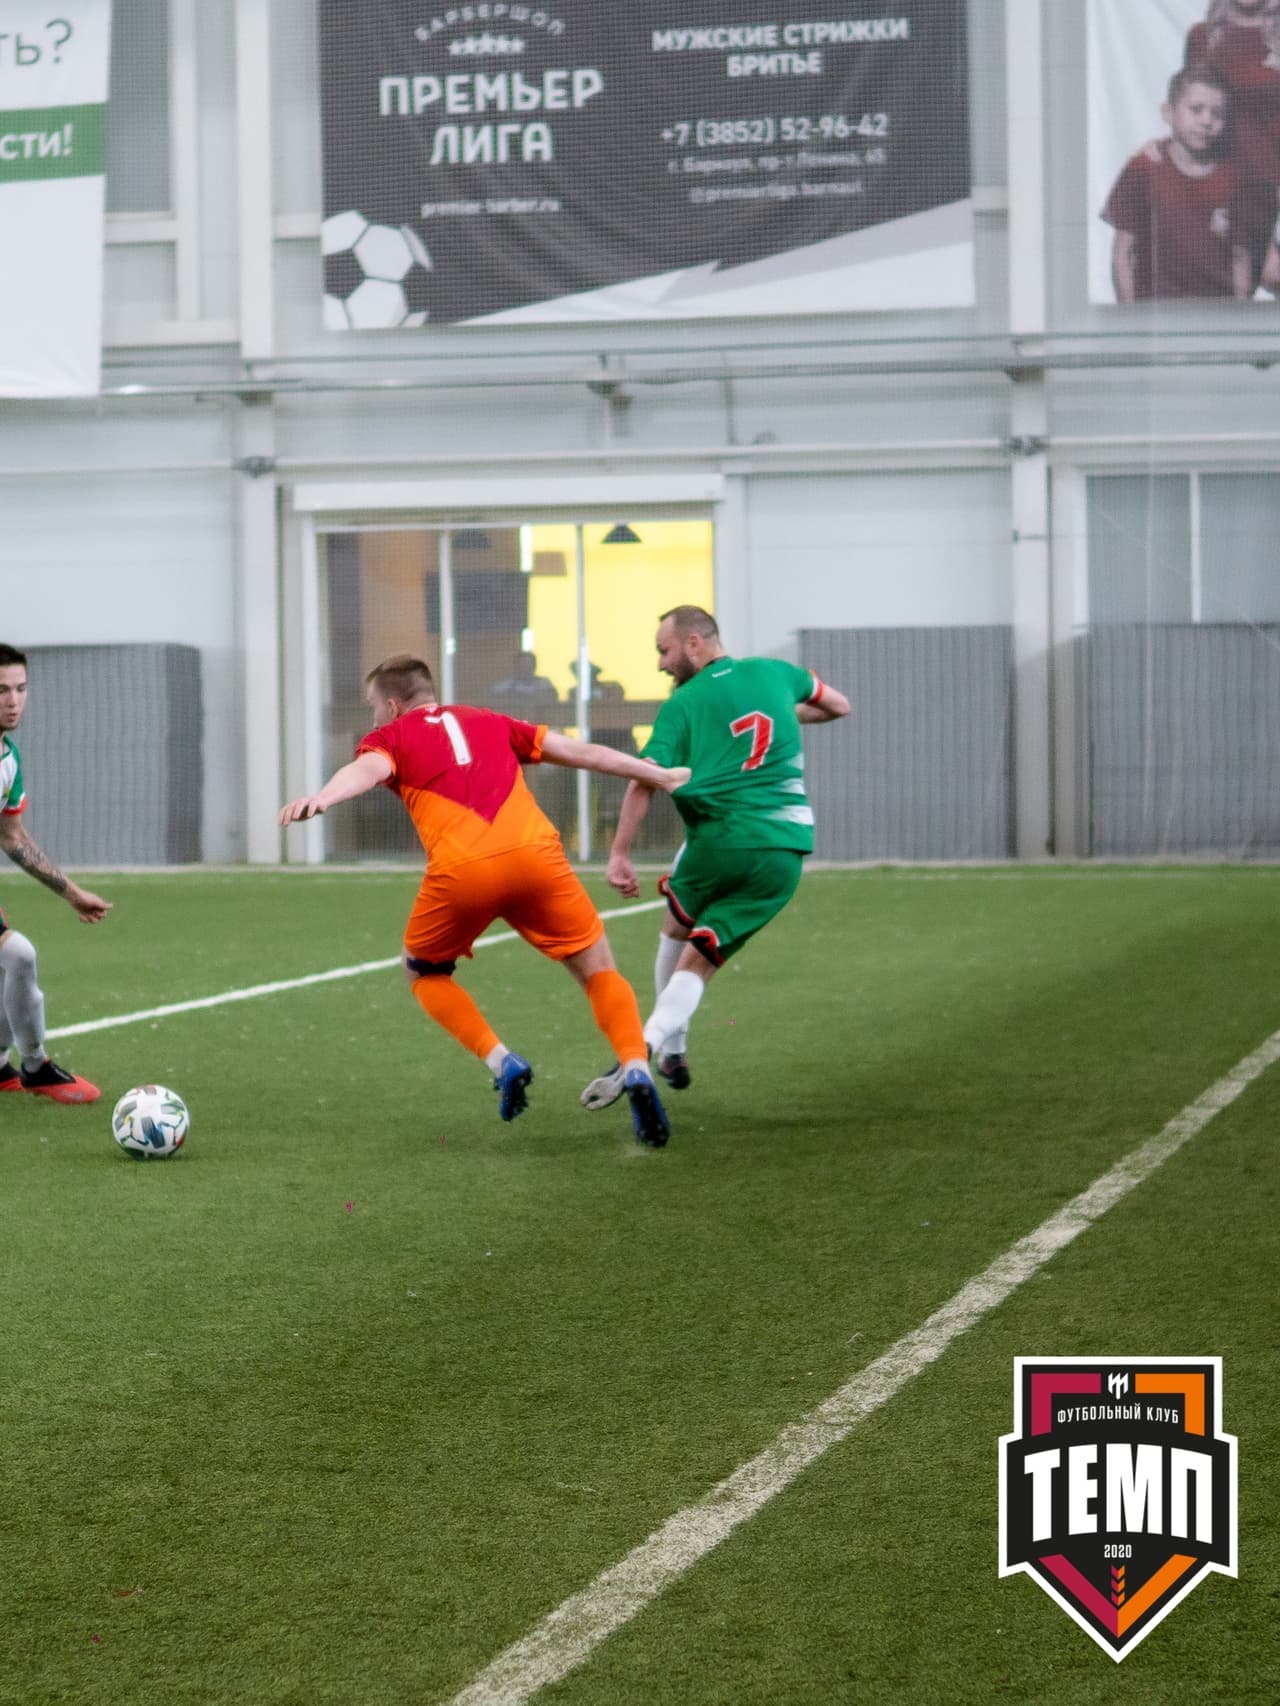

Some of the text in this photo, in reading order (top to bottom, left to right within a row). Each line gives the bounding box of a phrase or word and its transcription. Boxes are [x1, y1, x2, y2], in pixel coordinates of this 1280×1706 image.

[651, 18, 910, 51] МУЖСКИЕ СТРИЖКИ
[726, 52, 823, 78] БРИТЬЕ
[378, 68, 605, 116] ПРЕМЬЕР
[428, 122, 555, 166] ЛИГА
[660, 113, 889, 147] +7 (3852) 52-96-42
[424, 711, 472, 766] 1
[729, 710, 775, 772] 7
